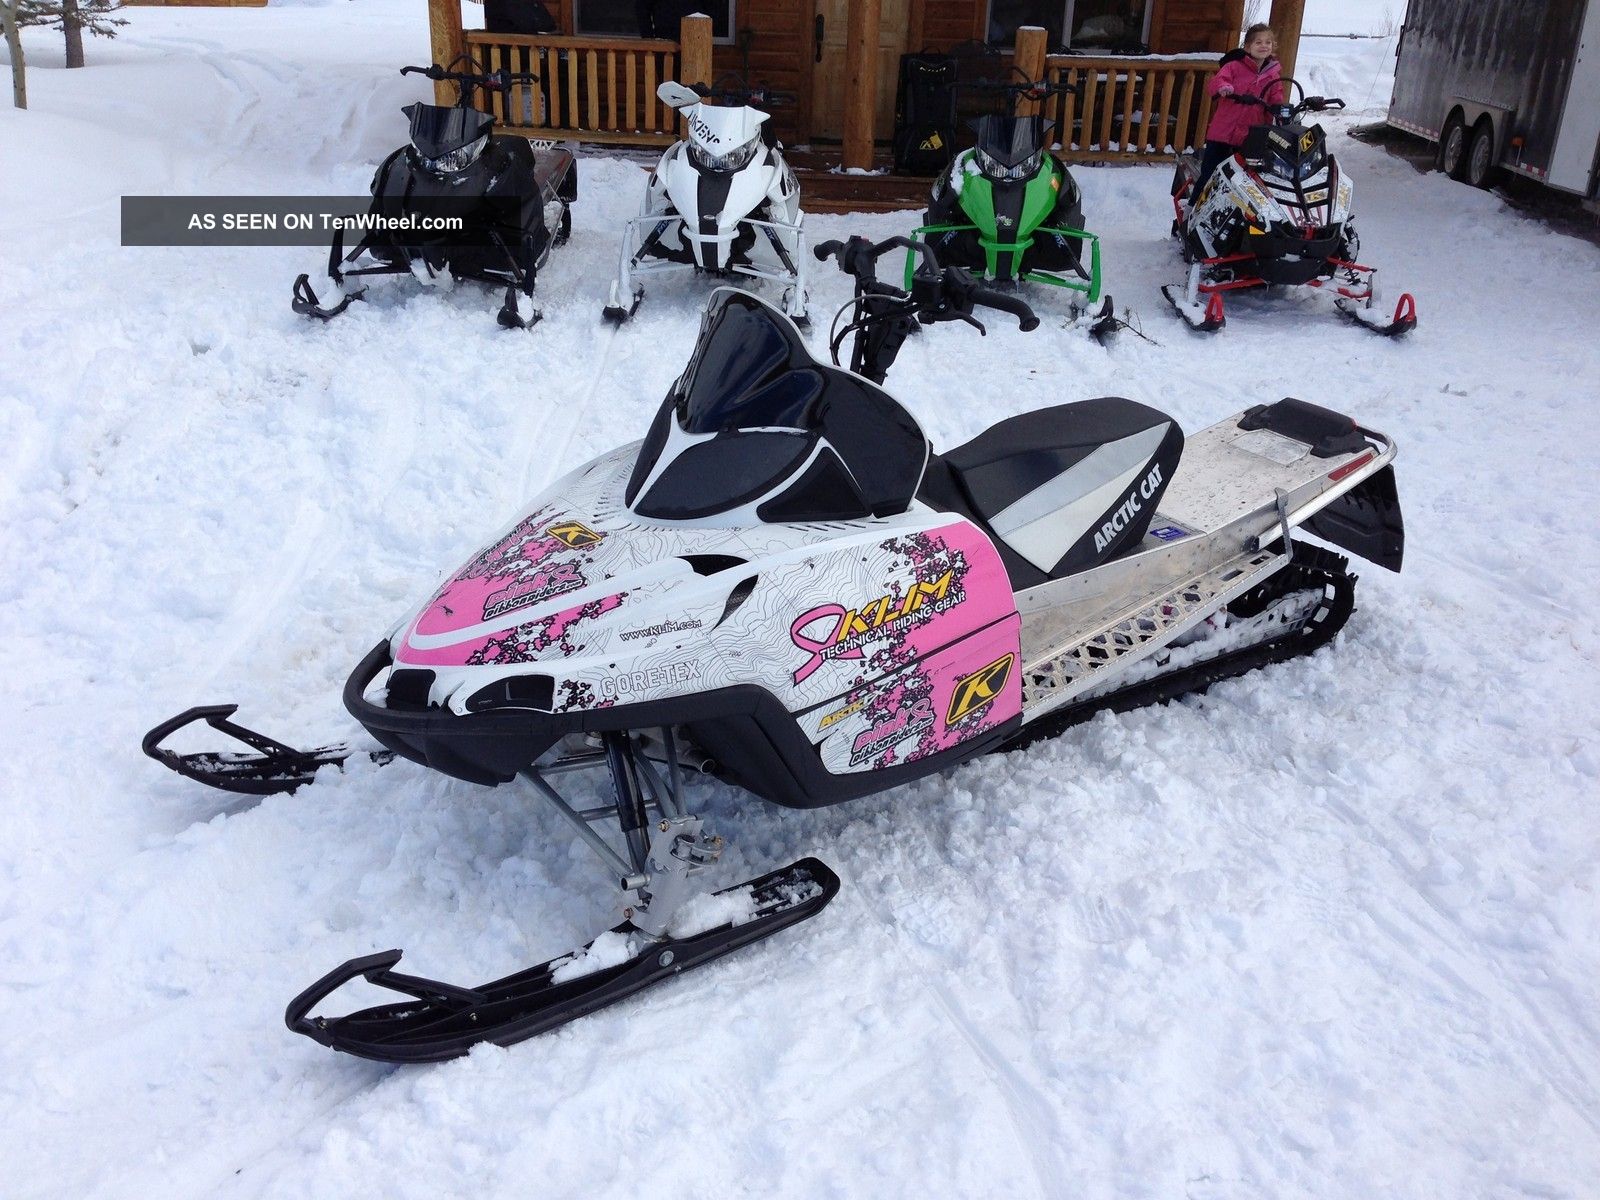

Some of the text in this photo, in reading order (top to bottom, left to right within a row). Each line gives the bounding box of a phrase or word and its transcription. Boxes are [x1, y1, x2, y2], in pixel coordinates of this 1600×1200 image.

[1094, 463, 1163, 554] ARCTIC CAT
[819, 591, 967, 661] TECHNICAL RIDING GEAR
[836, 569, 954, 643] KLIM
